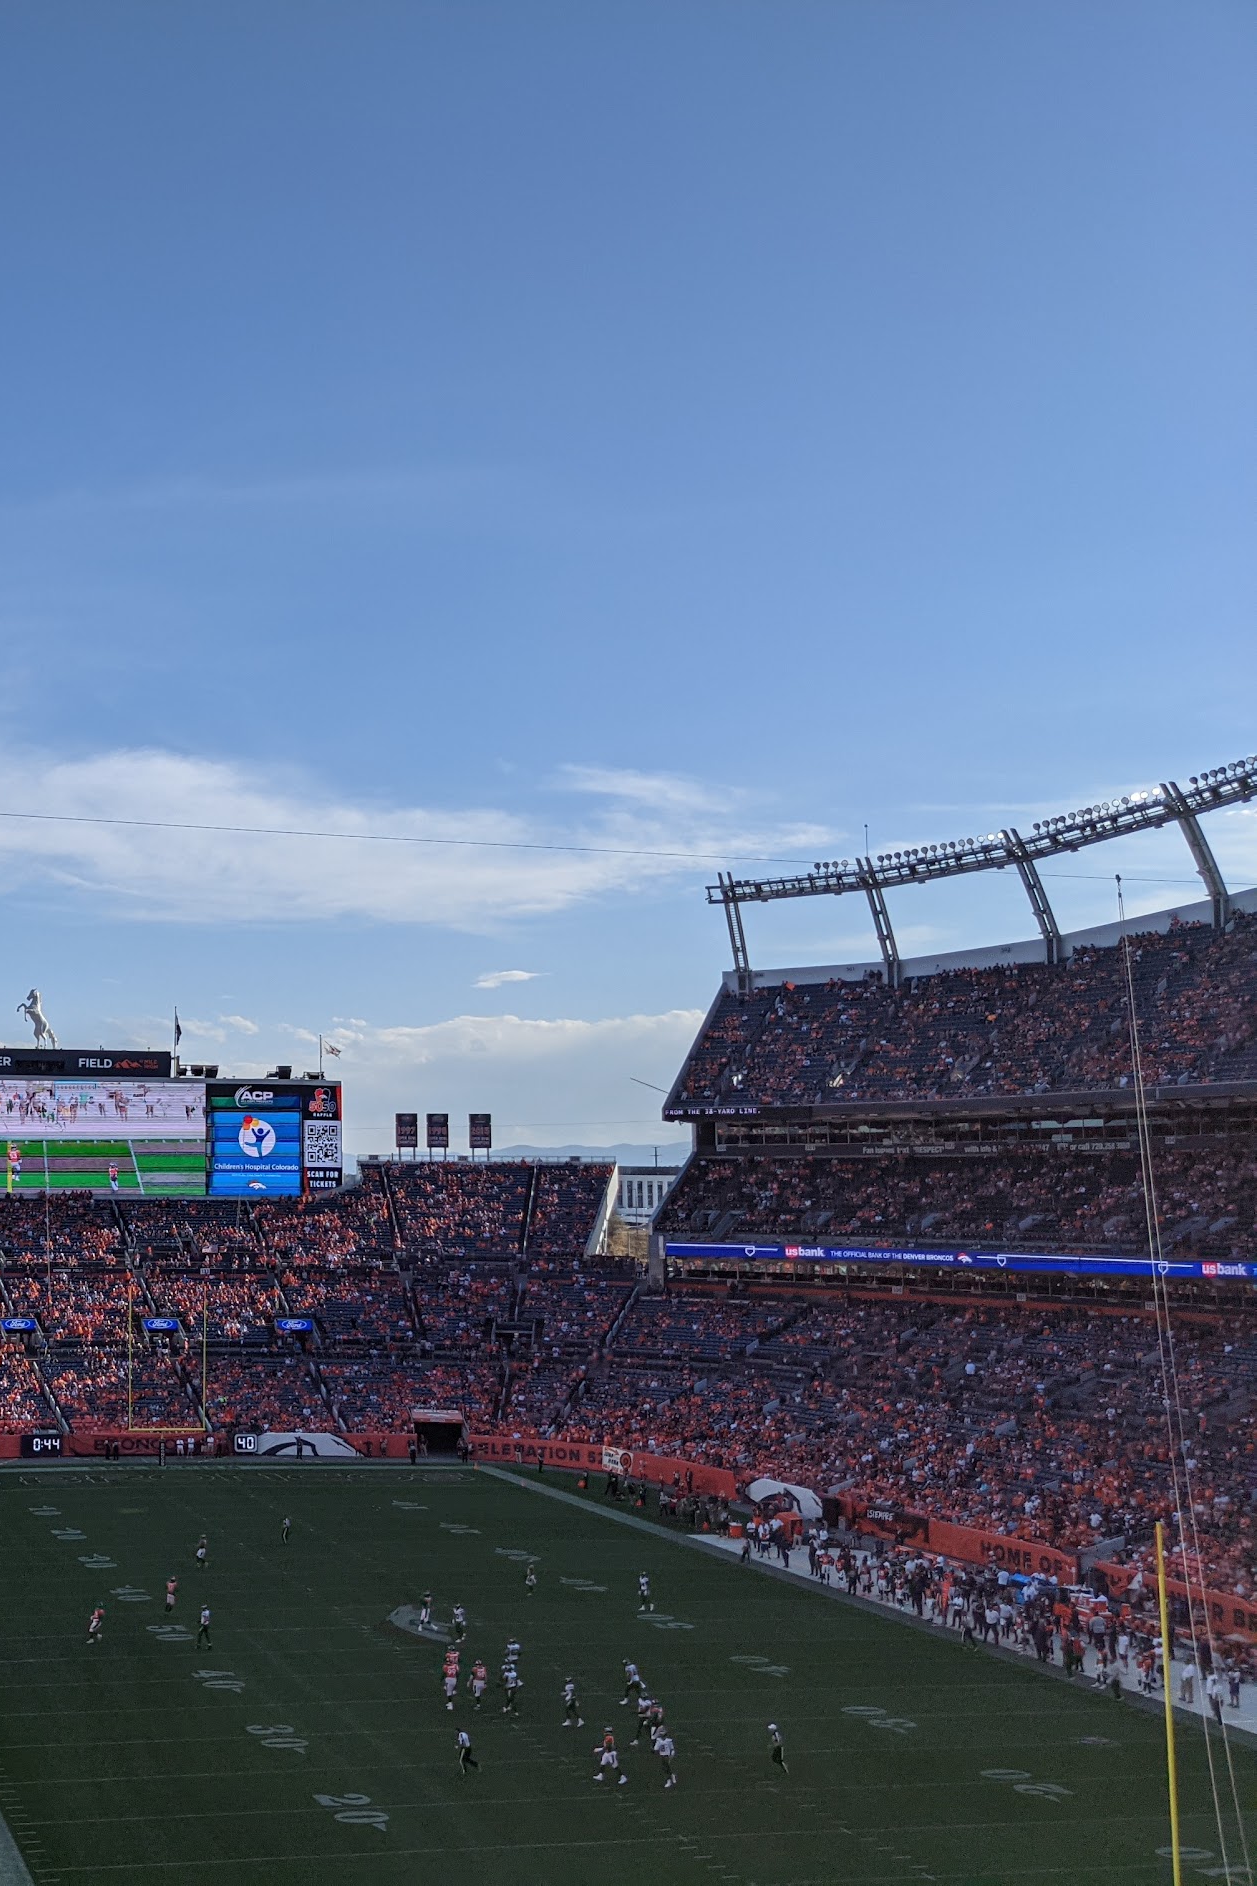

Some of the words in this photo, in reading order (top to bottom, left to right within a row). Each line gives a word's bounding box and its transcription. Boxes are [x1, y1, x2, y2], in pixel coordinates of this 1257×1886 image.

[78, 1058, 113, 1068] FIELD
[241, 1091, 274, 1100] ACP
[308, 1101, 336, 1112] 5050
[33, 1438, 60, 1451] 0:44
[238, 1438, 254, 1450] 40
[478, 1443, 580, 1462] ELEATION
[78, 1556, 118, 1568] 30
[981, 1542, 1032, 1569] HOME
[1039, 1556, 1062, 1572] OF
[146, 1625, 196, 1641] 50
[191, 1670, 246, 1689] 40
[841, 1706, 918, 1729] 30
[245, 1724, 310, 1748] 30
[980, 1769, 1076, 1796] 20
[312, 1793, 390, 1824] 20
